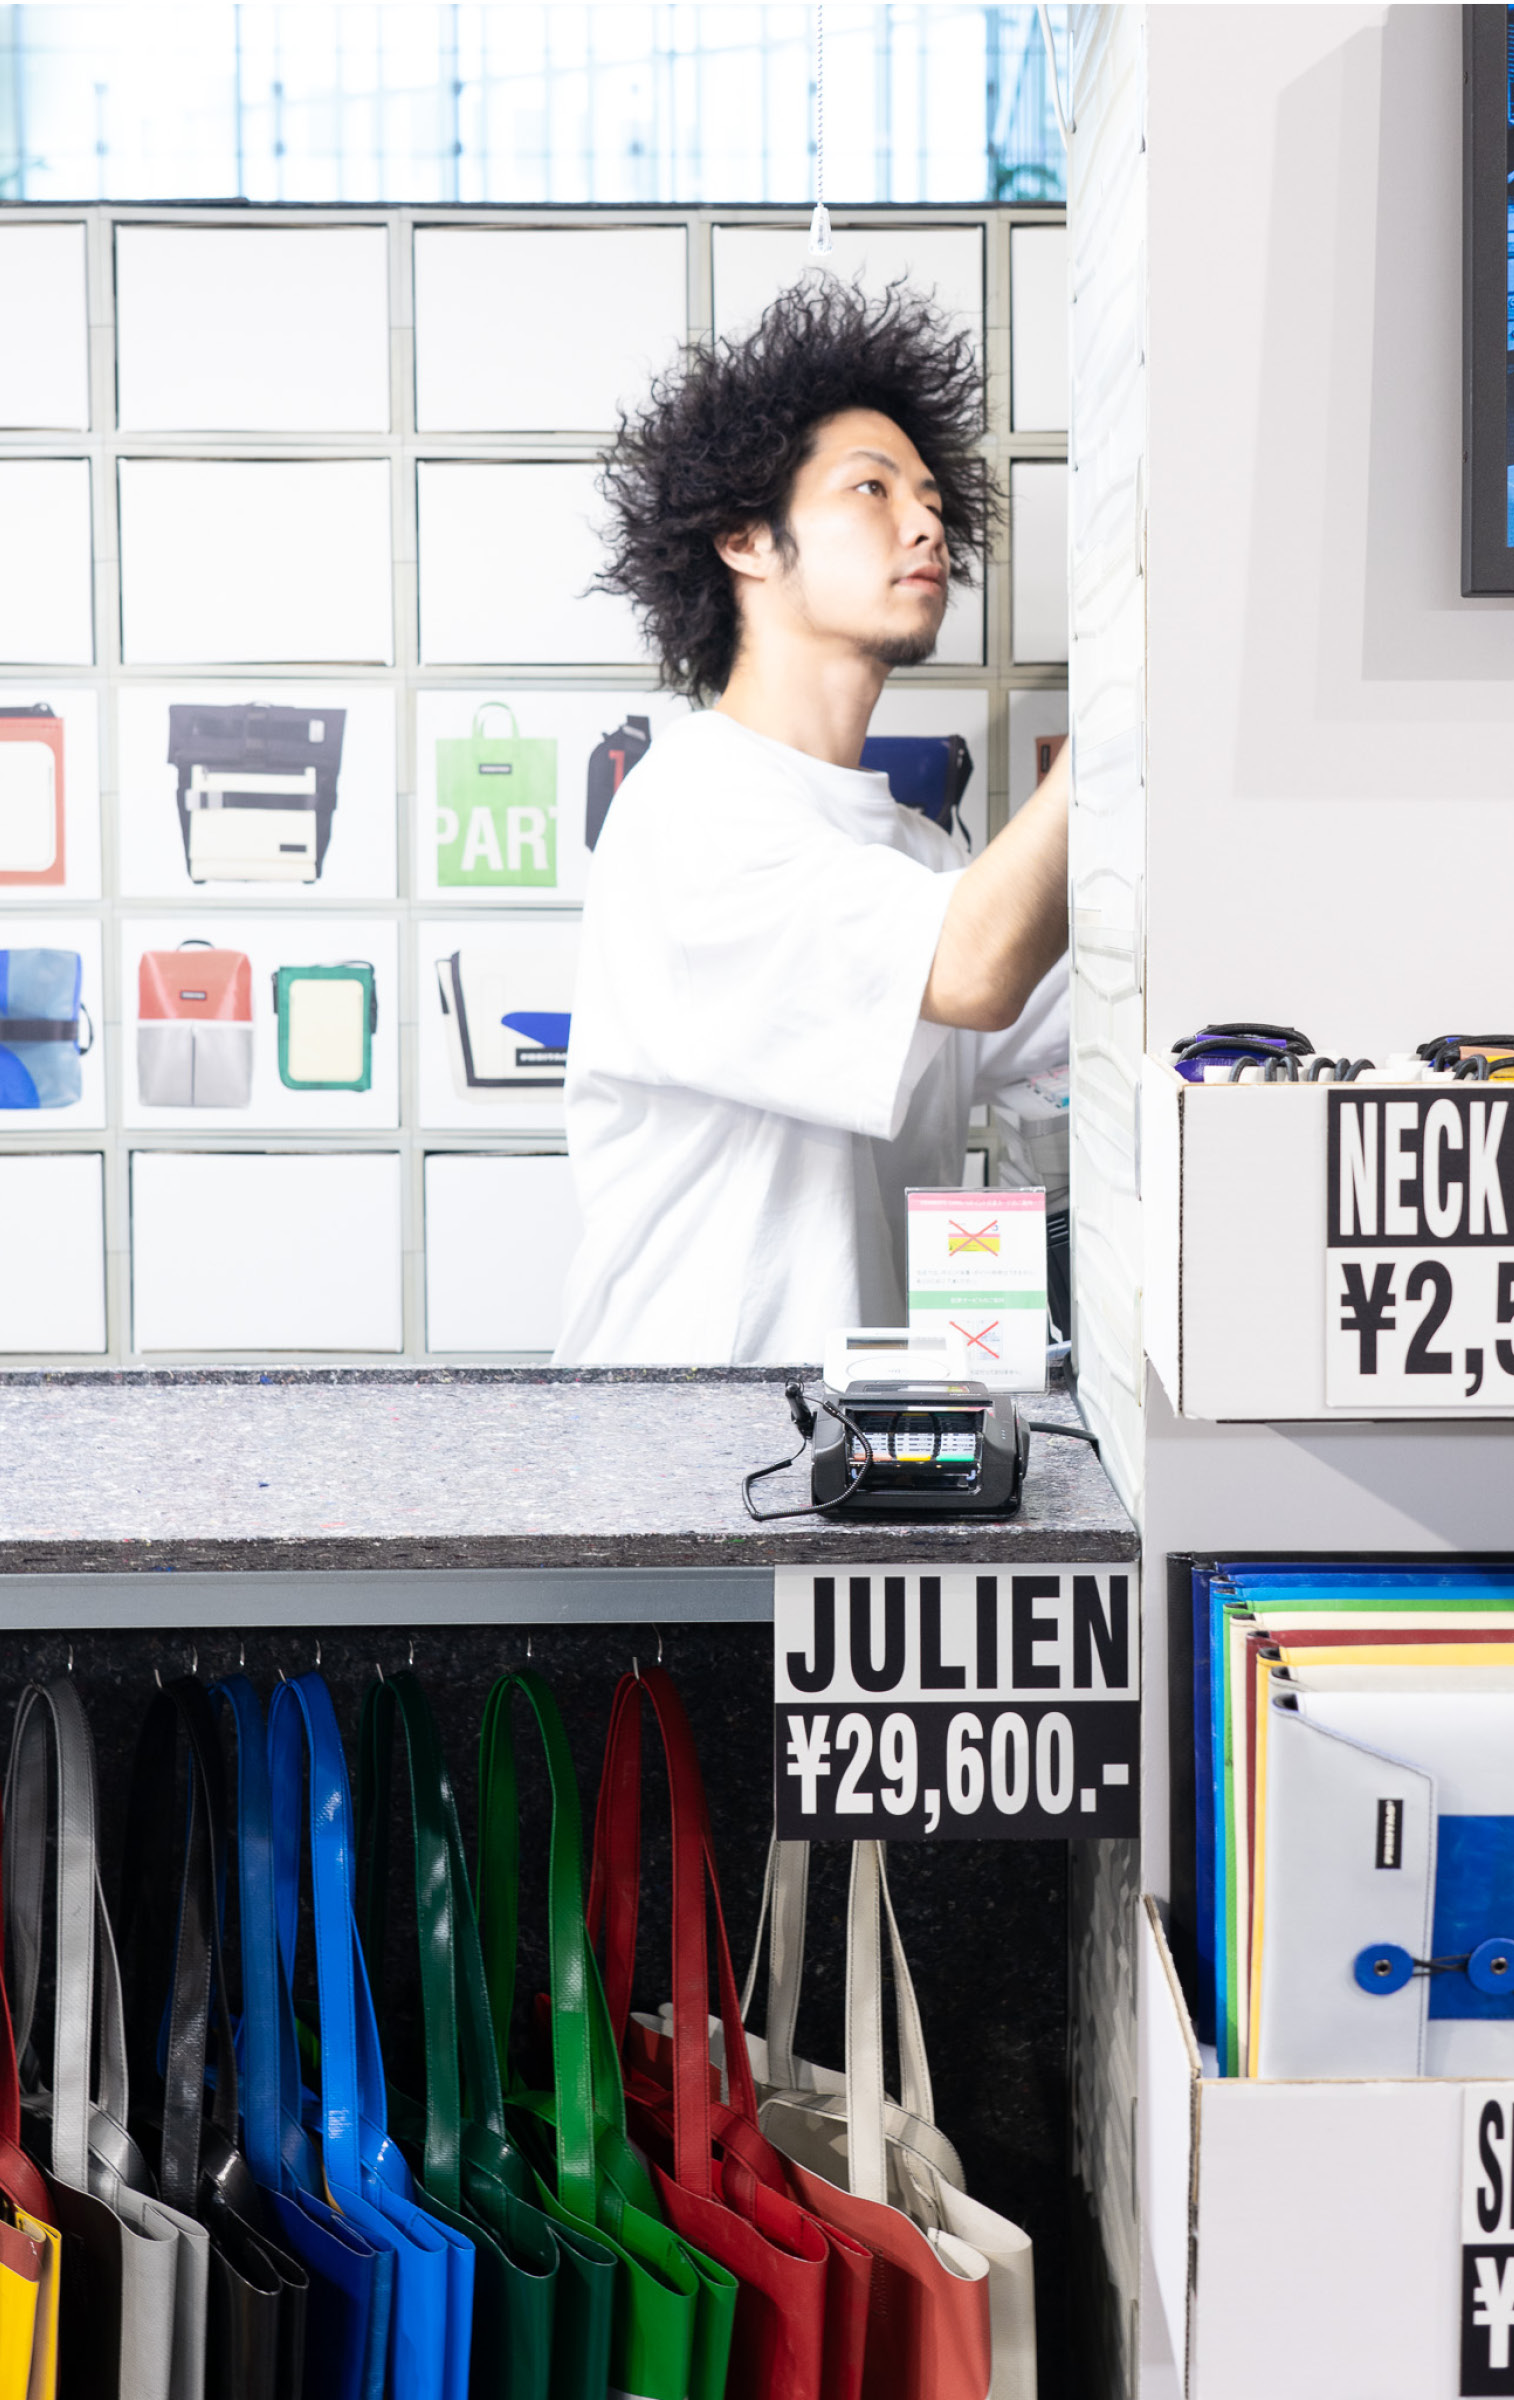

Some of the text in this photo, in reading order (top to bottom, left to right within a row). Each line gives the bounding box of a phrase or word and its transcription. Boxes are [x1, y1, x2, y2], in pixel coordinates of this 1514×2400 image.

[1339, 1098, 1509, 1239] NECK
[786, 1574, 1129, 1693] JULIEN
[786, 1711, 1129, 1834] ¥29,600.-
[1476, 2098, 1514, 2233] S
